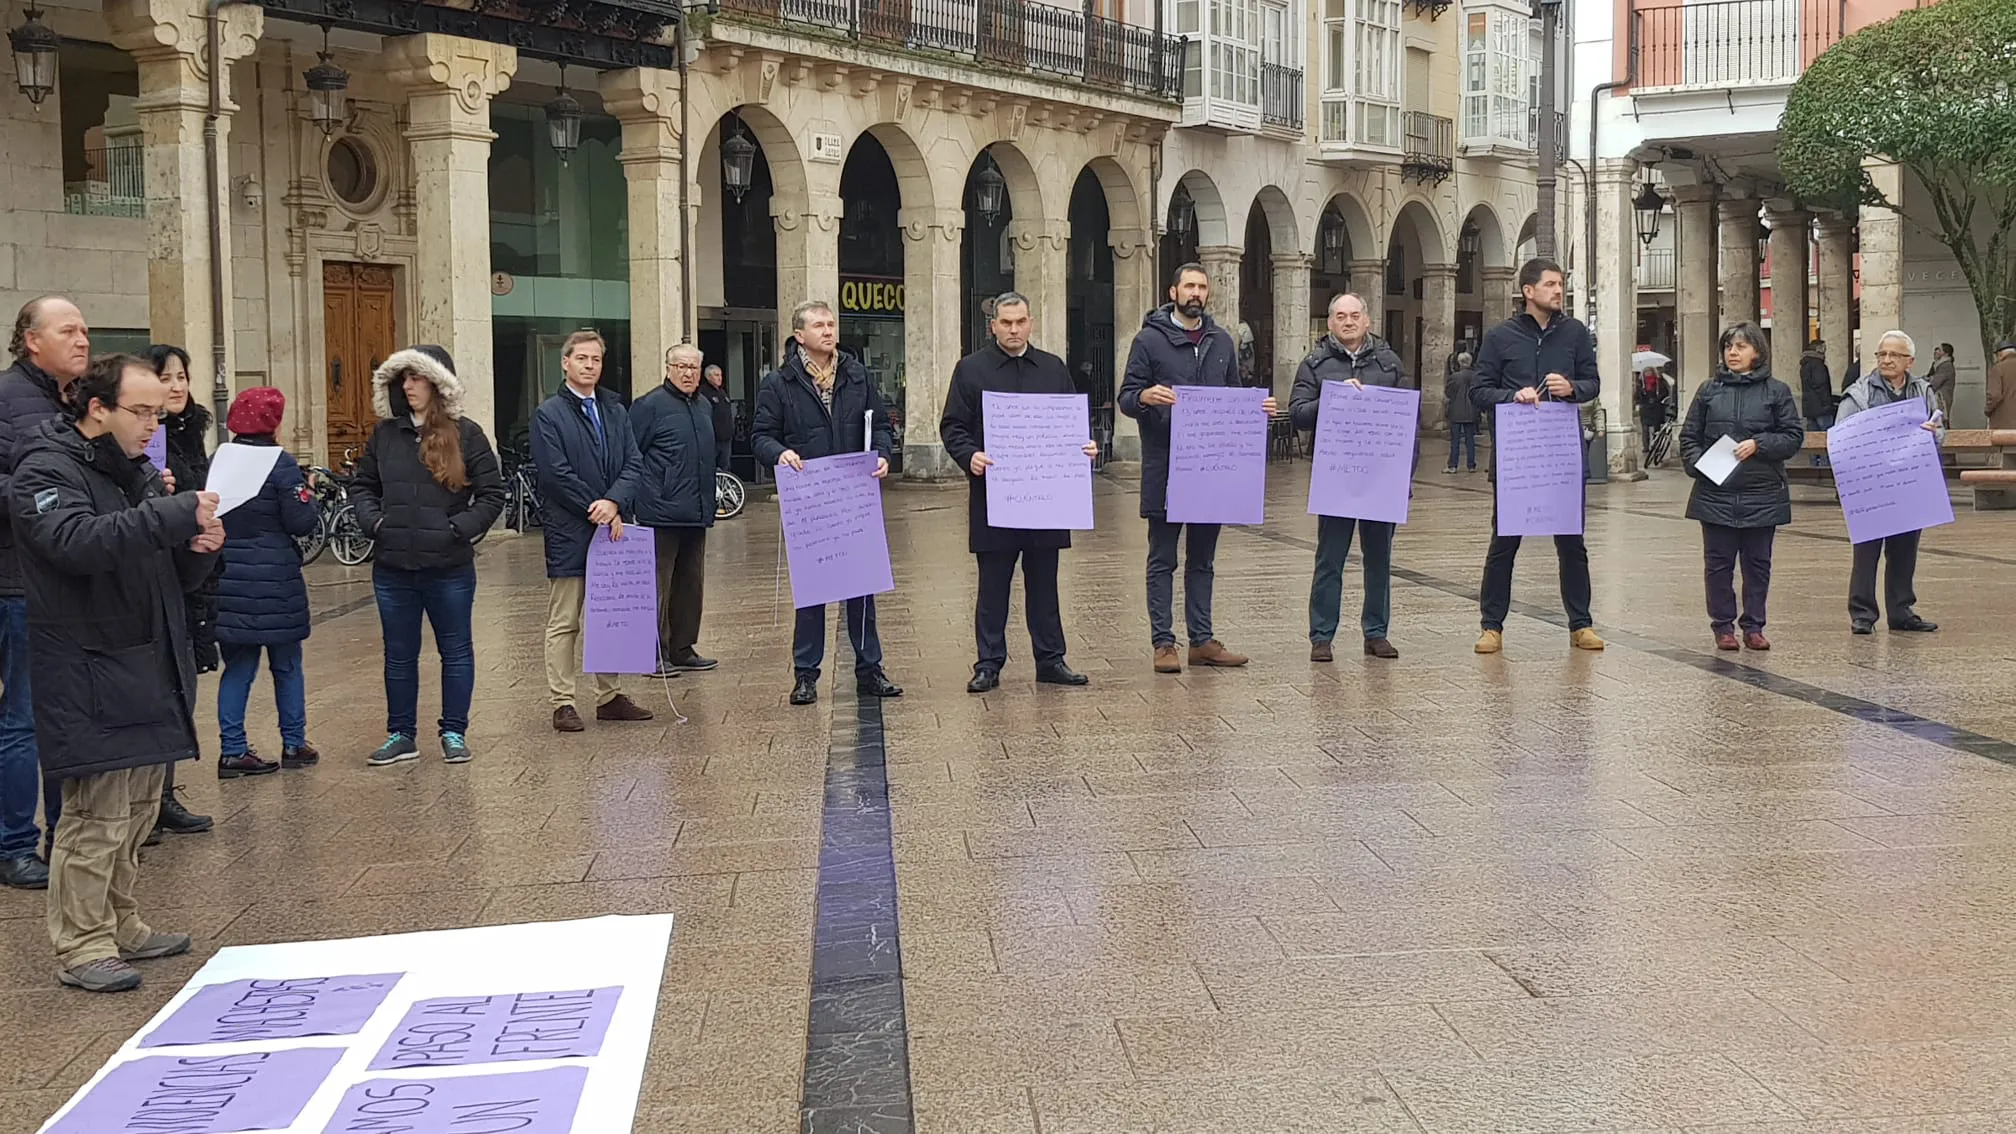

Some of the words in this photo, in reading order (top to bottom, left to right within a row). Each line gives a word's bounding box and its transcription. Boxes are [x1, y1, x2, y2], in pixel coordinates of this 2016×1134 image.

[422, 996, 493, 1015] AL
[490, 989, 594, 1056] FRENTE
[392, 1022, 476, 1061] PASO
